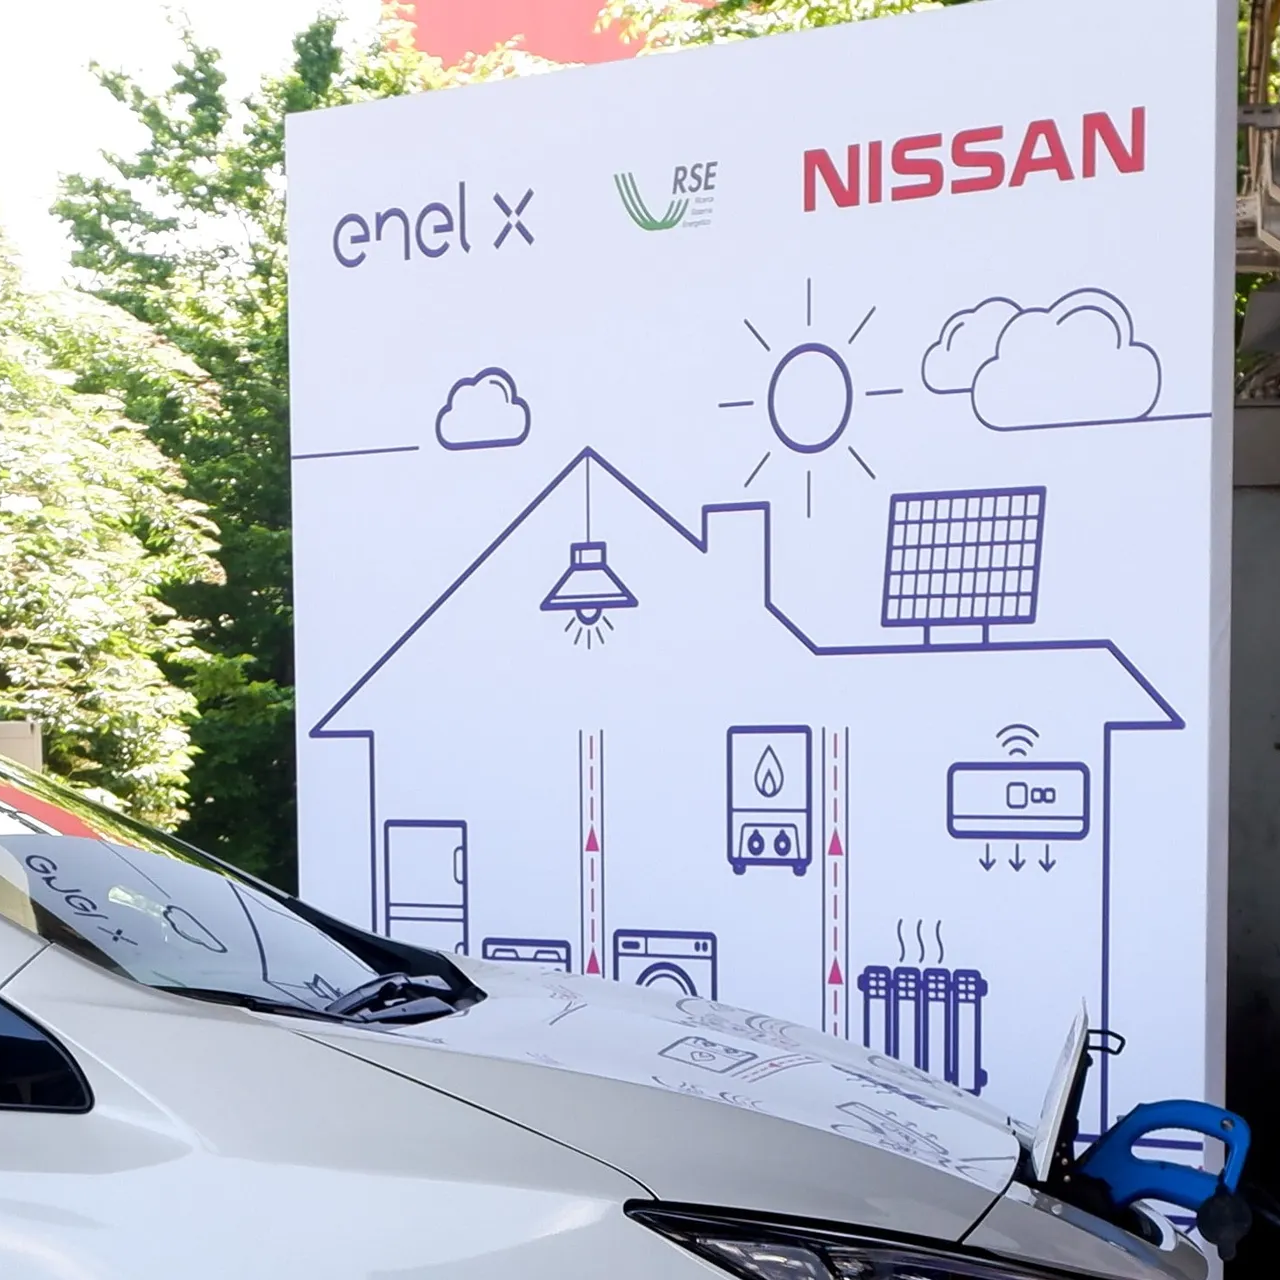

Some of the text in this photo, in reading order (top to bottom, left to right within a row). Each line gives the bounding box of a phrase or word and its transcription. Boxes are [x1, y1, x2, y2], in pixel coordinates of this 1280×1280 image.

[672, 161, 718, 195] RSE
[803, 106, 1147, 212] NISSAN
[333, 182, 534, 268] enel x
